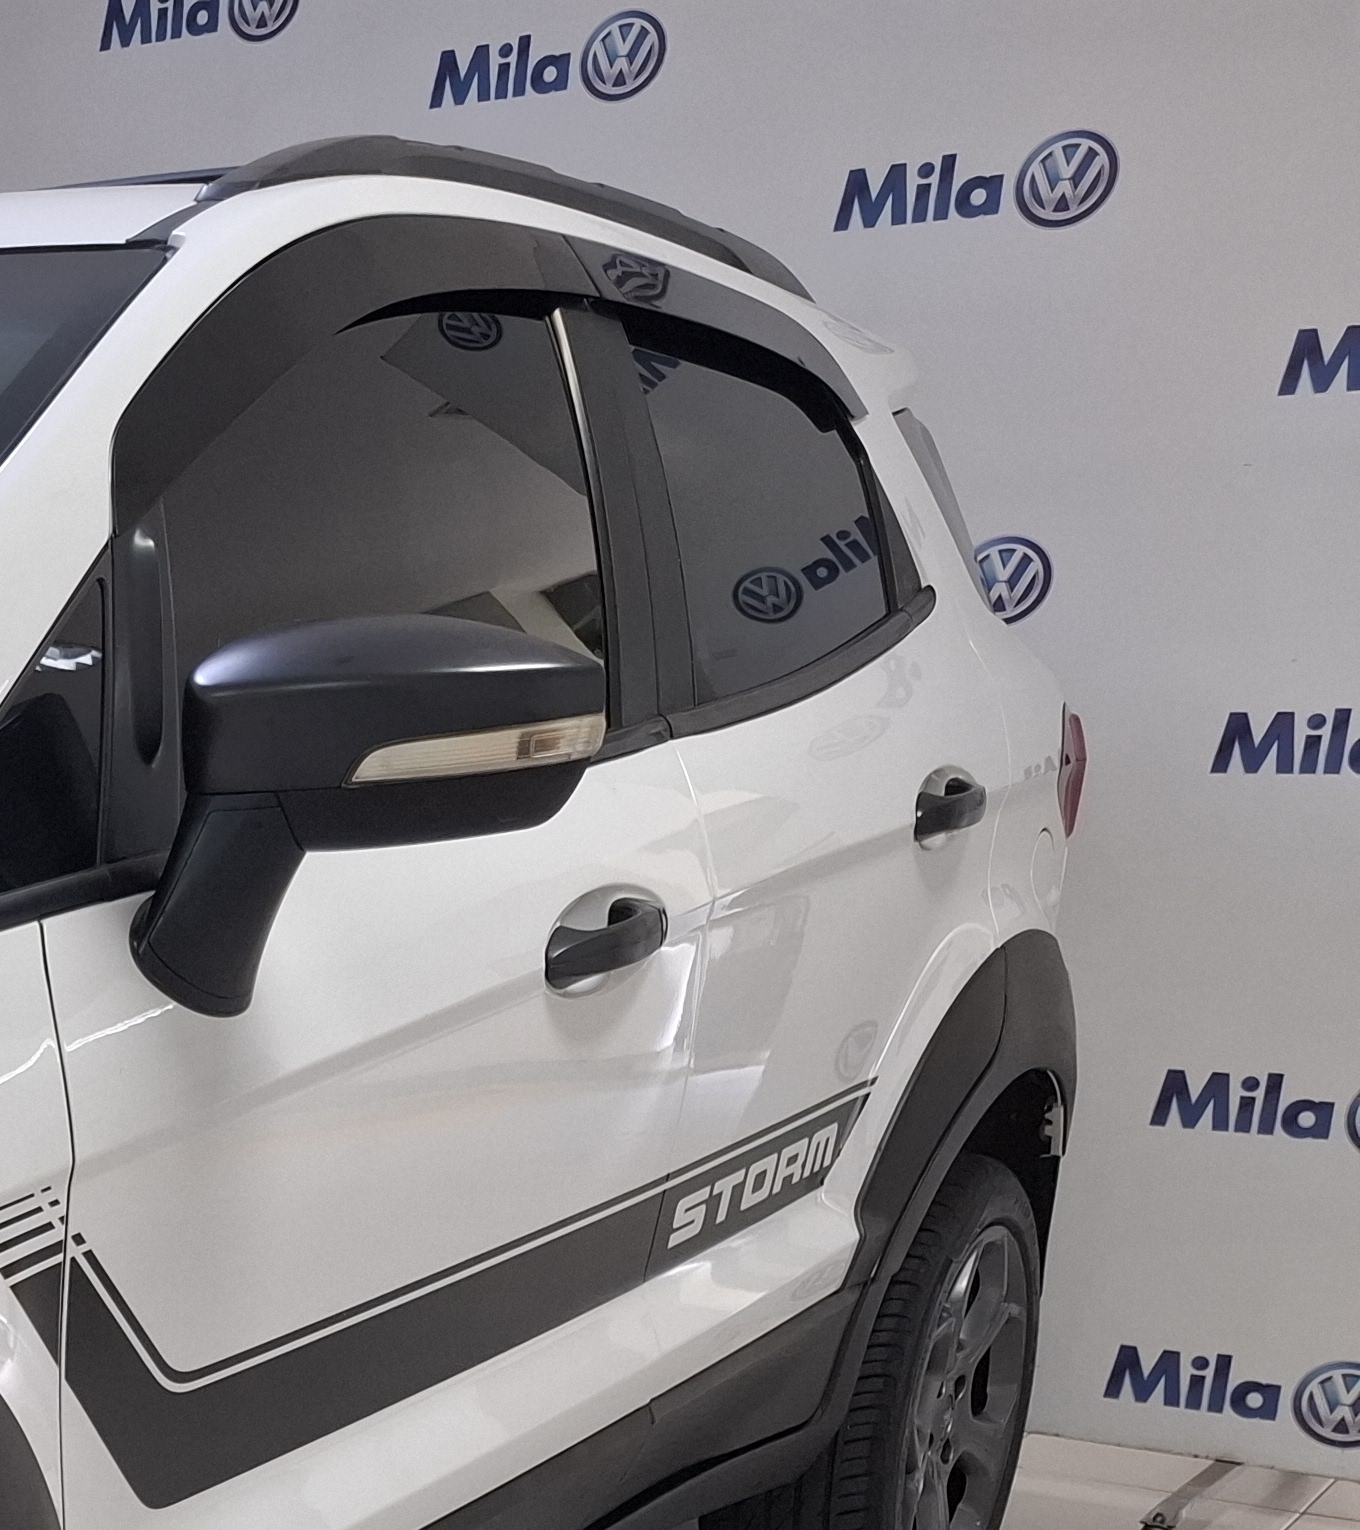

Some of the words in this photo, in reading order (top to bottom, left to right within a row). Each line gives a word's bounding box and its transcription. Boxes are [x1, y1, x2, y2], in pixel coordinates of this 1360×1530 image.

[99, 0, 220, 52] Mila
[428, 33, 572, 110] Mila
[832, 153, 1005, 233] Mila
[1210, 707, 1360, 775] Mil
[1148, 1068, 1336, 1141] Mila
[667, 1122, 839, 1250] STORM
[1102, 1343, 1282, 1422] Mila
